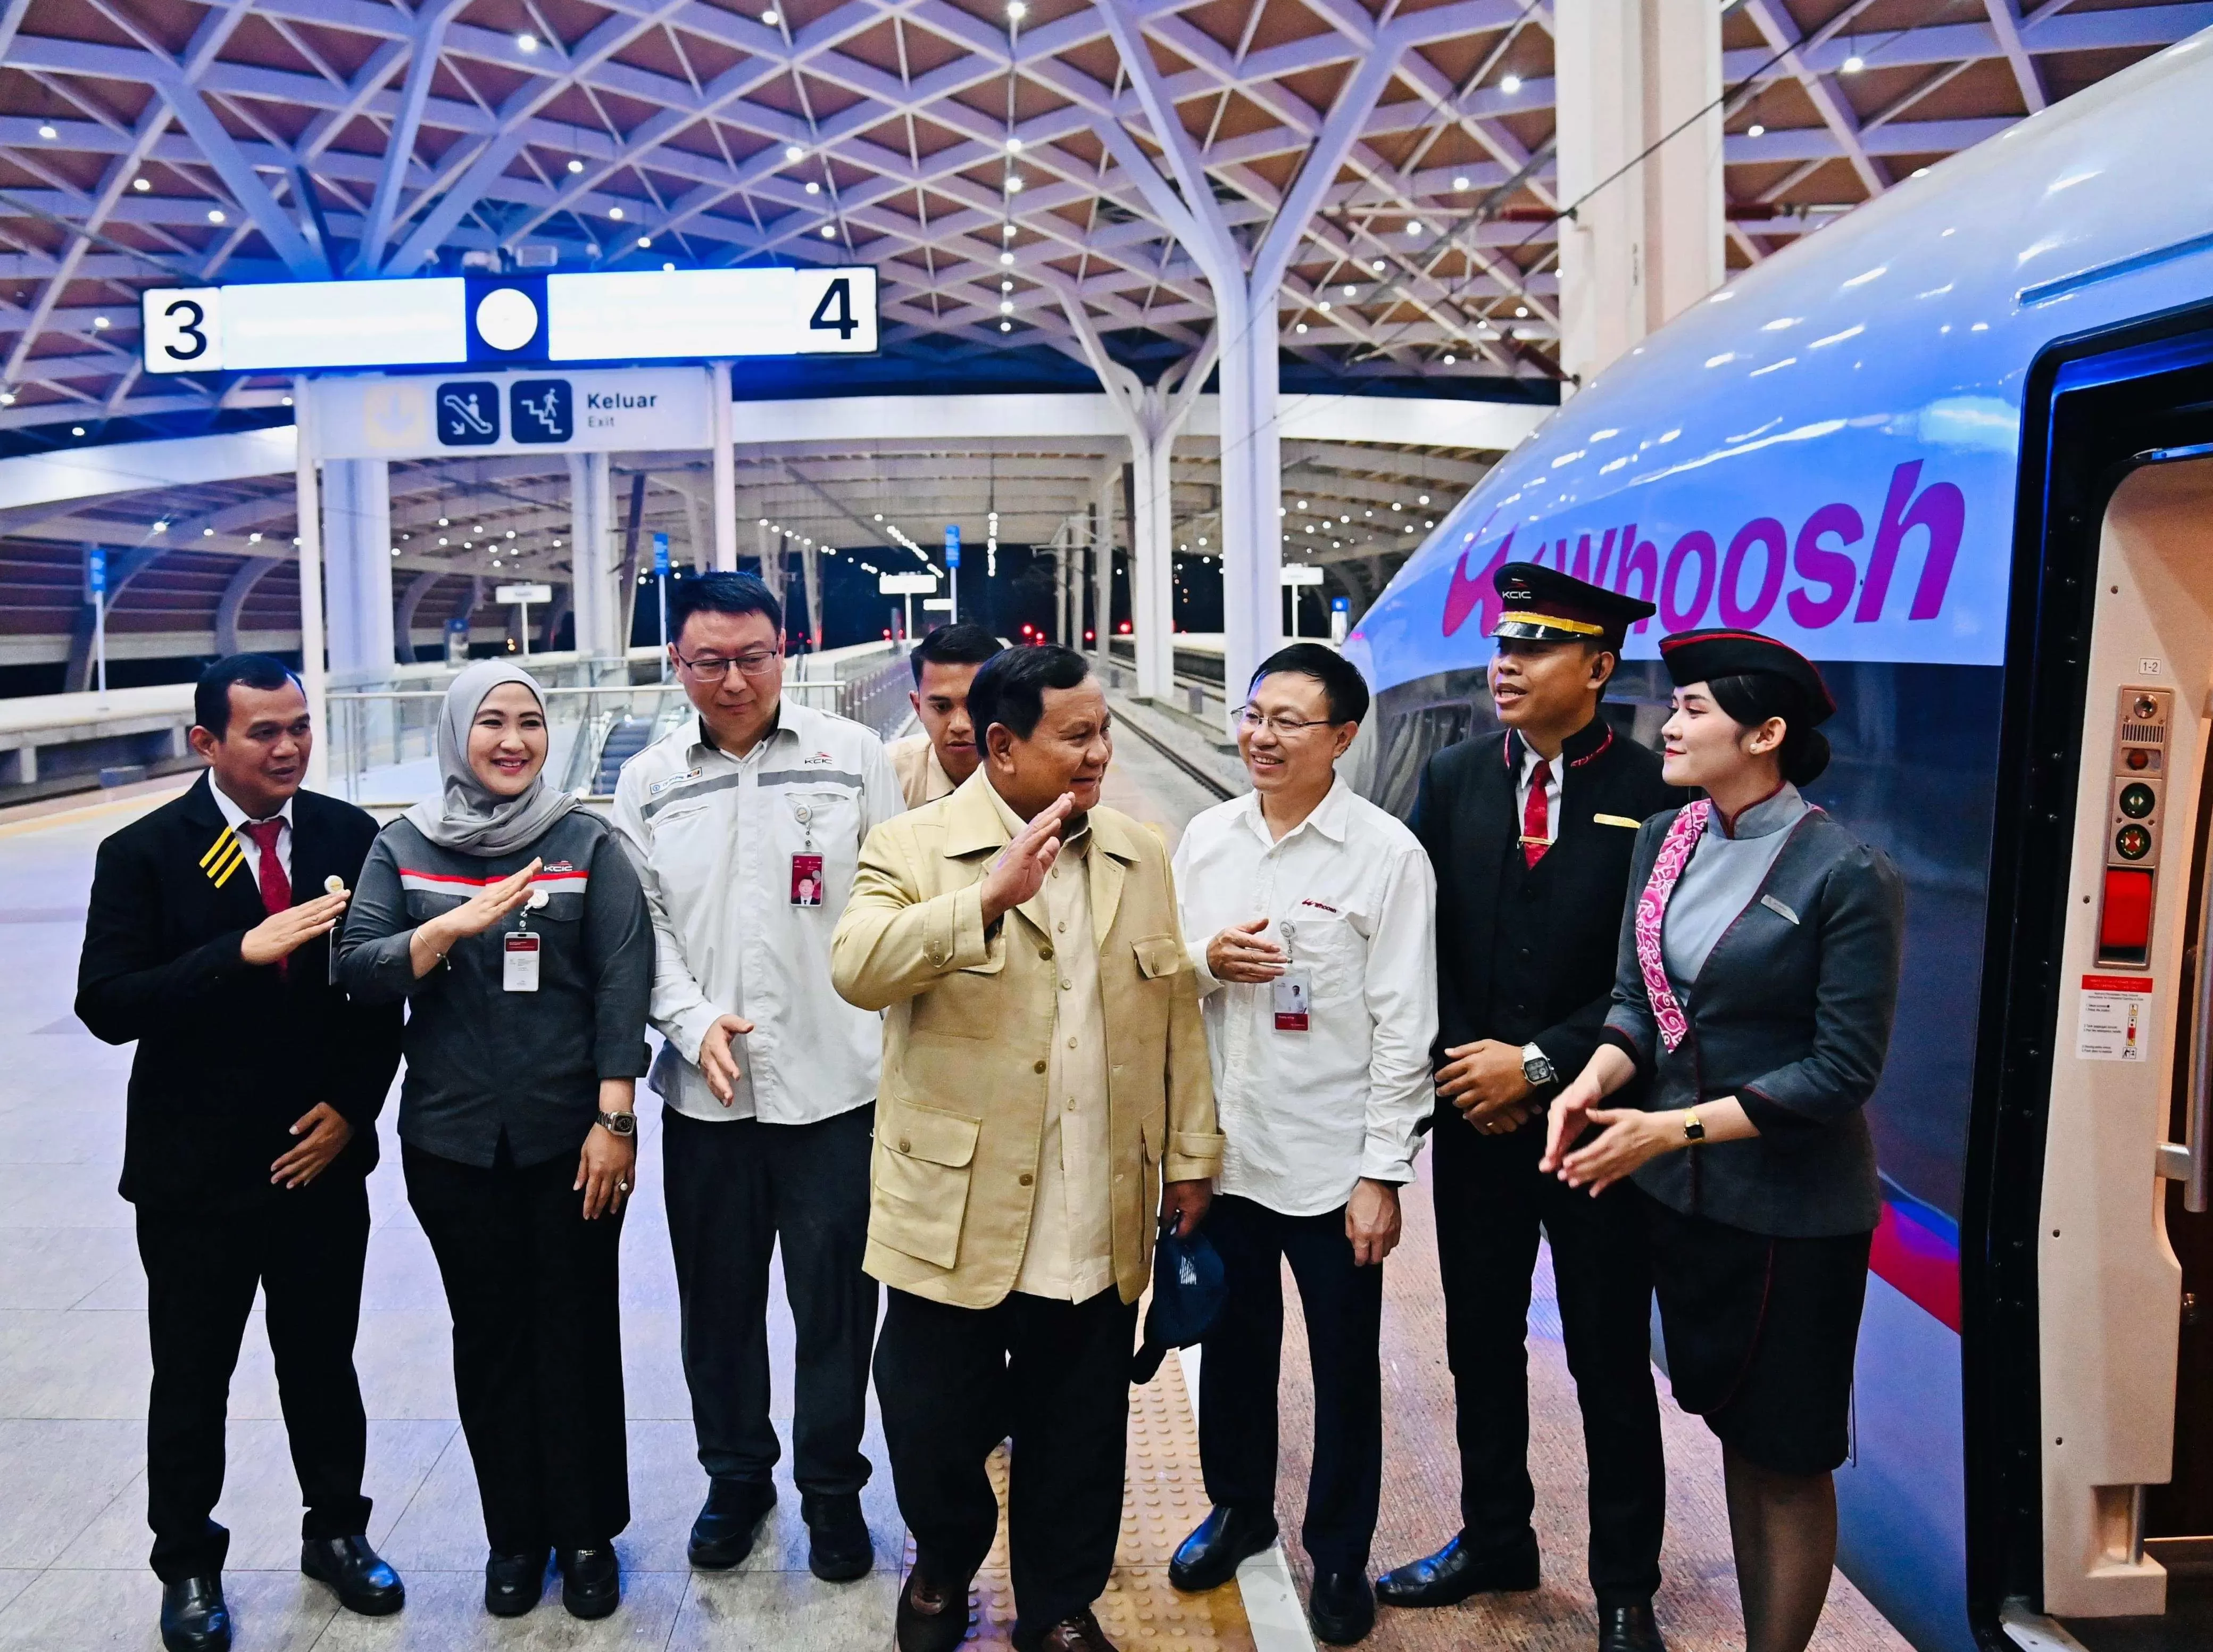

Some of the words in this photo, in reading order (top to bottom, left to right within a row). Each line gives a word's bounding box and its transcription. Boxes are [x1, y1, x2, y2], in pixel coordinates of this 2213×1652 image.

[809, 277, 859, 341] 4
[164, 300, 207, 361] 3
[587, 392, 658, 410] Keluar
[587, 416, 614, 428] Exit
[1501, 591, 1532, 599] KCIC
[2143, 661, 2158, 673] 1-2
